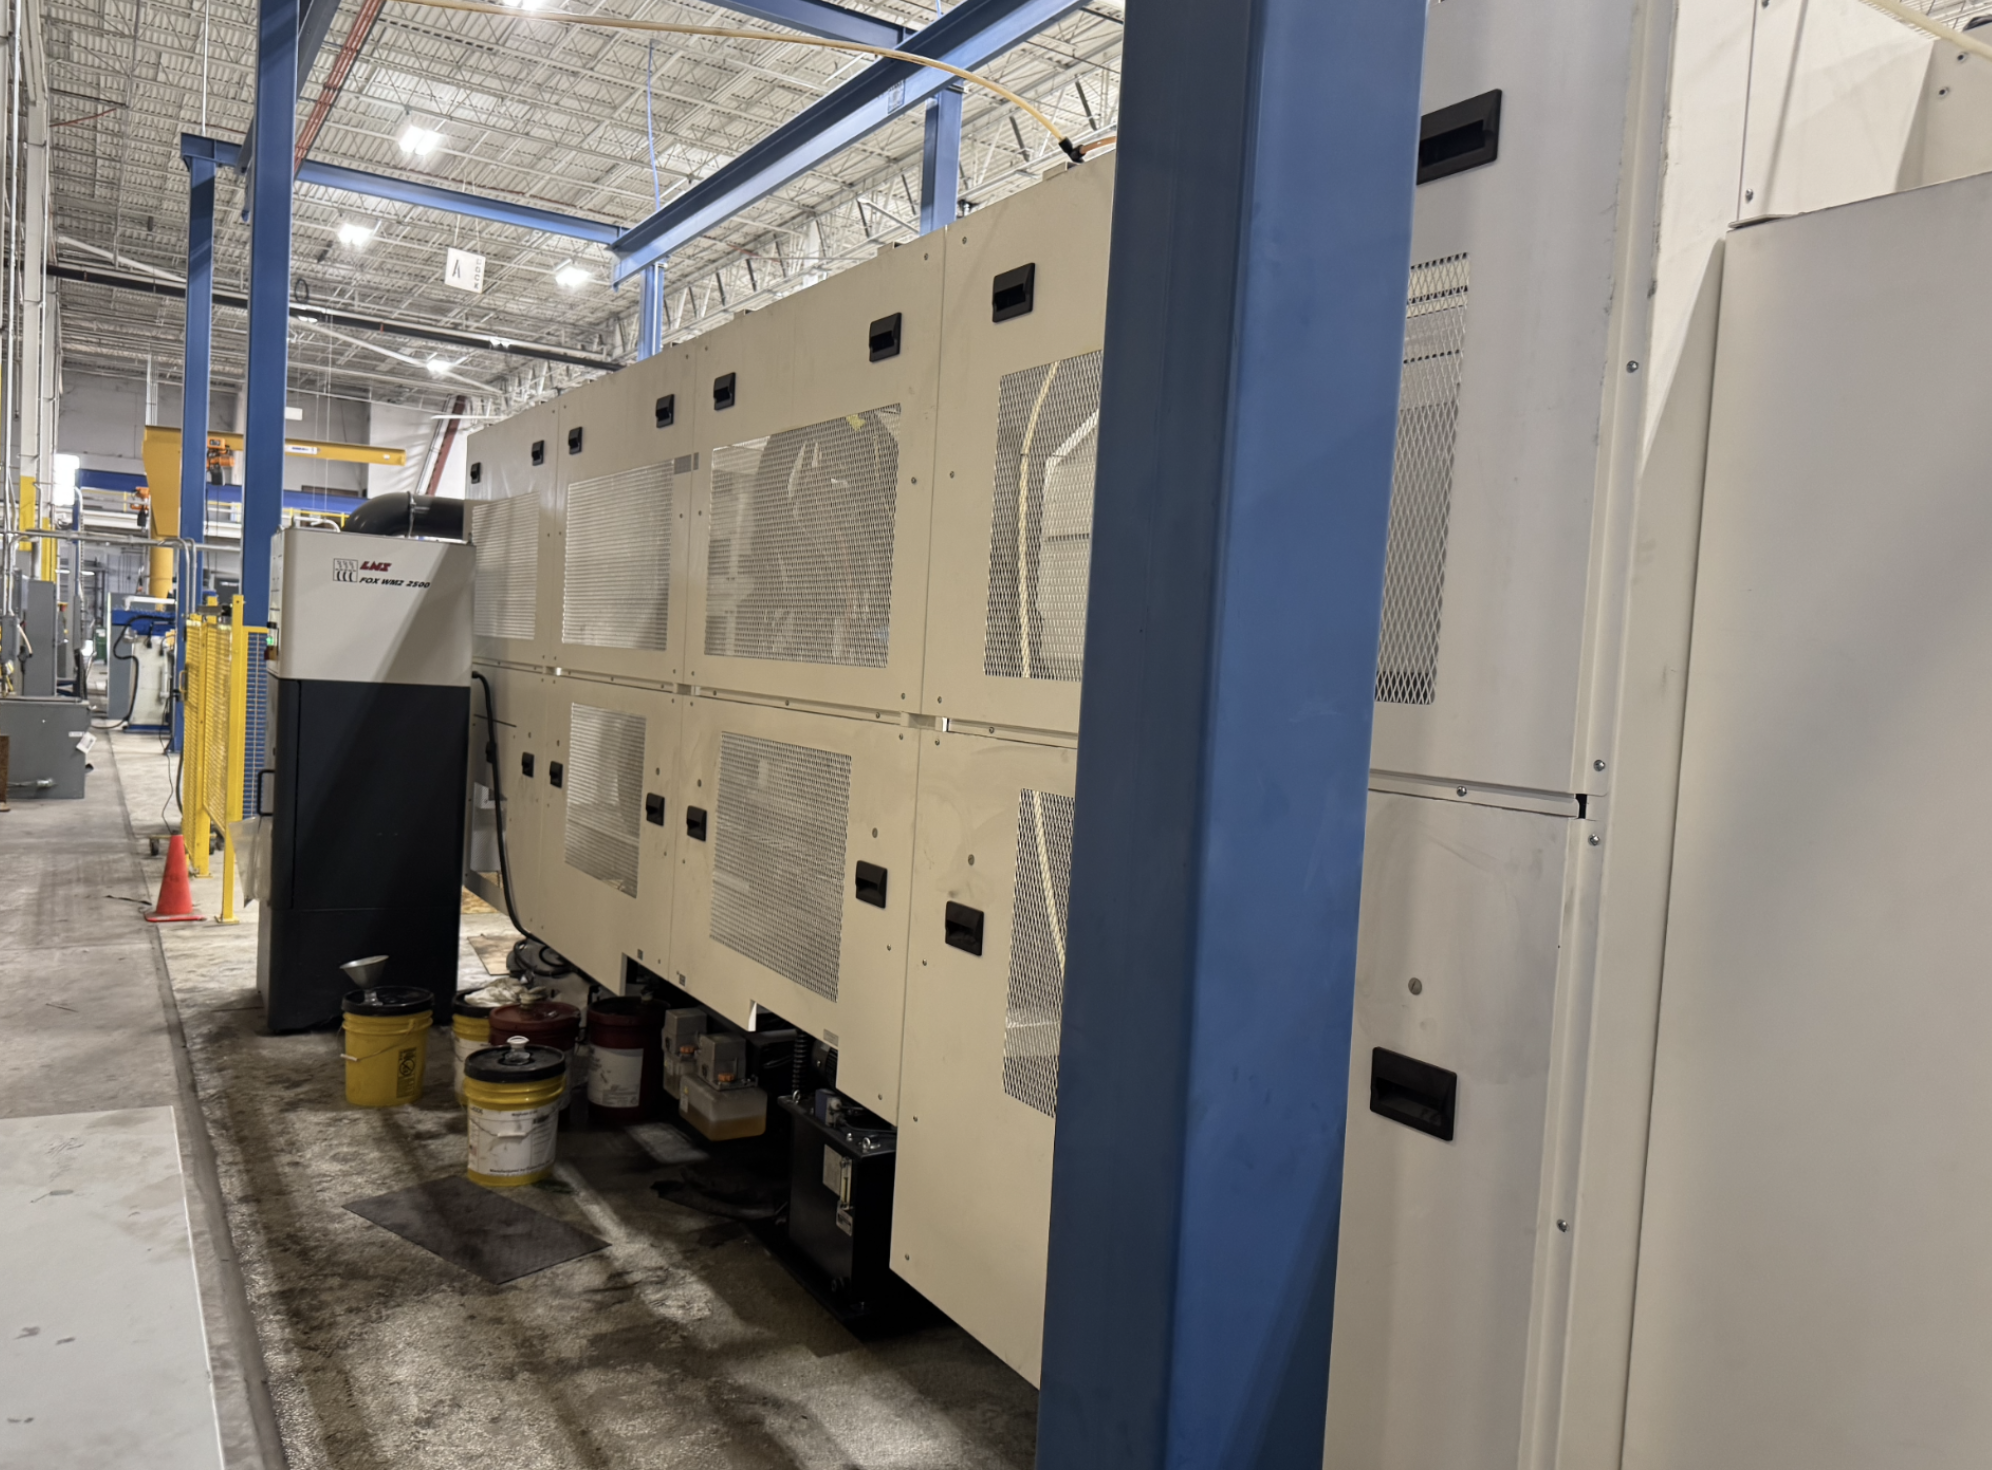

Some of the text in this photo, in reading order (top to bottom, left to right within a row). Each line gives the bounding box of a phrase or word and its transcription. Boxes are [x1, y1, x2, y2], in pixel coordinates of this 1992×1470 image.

[359, 560, 392, 572] LNS
[359, 577, 380, 585] FOX
[405, 580, 430, 589] 2500
